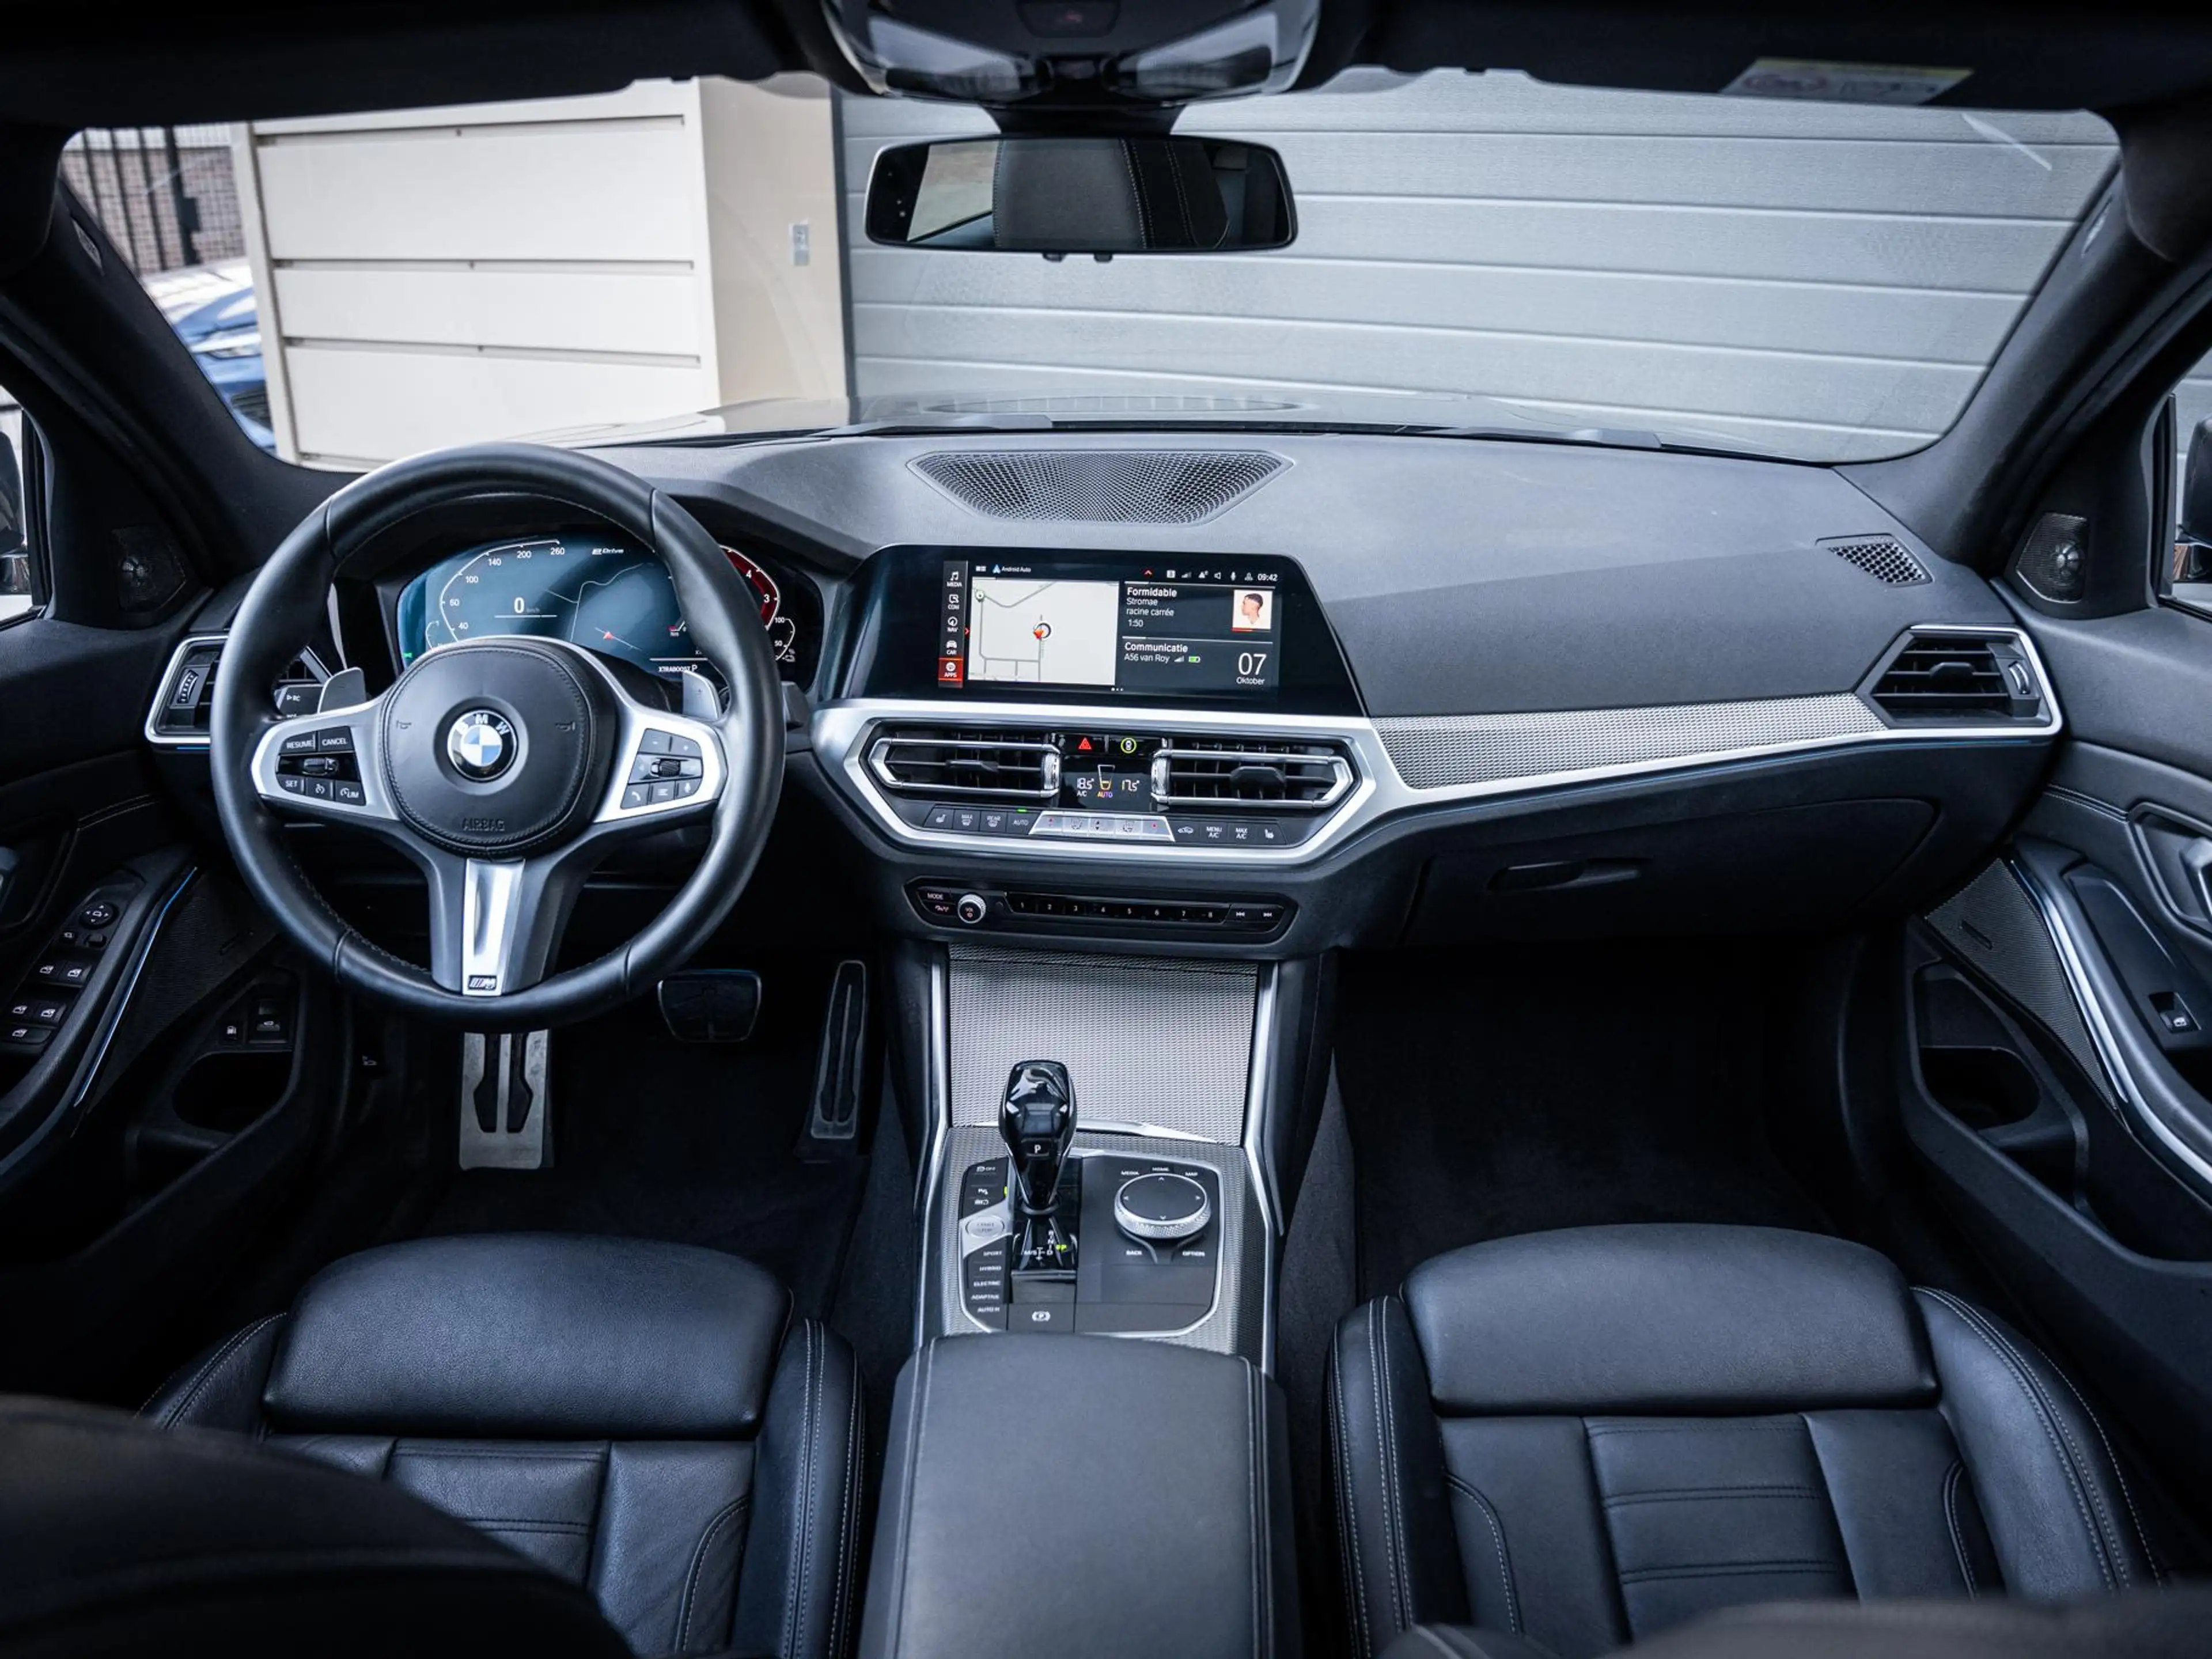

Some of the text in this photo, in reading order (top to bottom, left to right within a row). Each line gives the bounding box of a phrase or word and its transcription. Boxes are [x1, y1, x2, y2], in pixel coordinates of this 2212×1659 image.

[517, 551, 532, 559] 200
[551, 547, 565, 555] 260
[488, 558, 501, 566] 140
[746, 570, 752, 578] 4
[465, 575, 479, 584] 100
[1127, 588, 1177, 597] Formidable
[764, 594, 770, 603] 3
[1127, 597, 1158, 606] Stromae
[514, 597, 524, 613] 0
[1150, 608, 1174, 616] carrée
[1124, 642, 1188, 652] Communicatie
[1156, 654, 1171, 664] Roy
[1238, 652, 1267, 676] 07
[1236, 676, 1265, 685] Oktober
[286, 740, 313, 749] RESUME
[322, 737, 347, 745] CANCEL
[347, 790, 359, 798] LIM
[462, 818, 505, 832] AIRBAG
[1035, 1144, 1041, 1153] P
